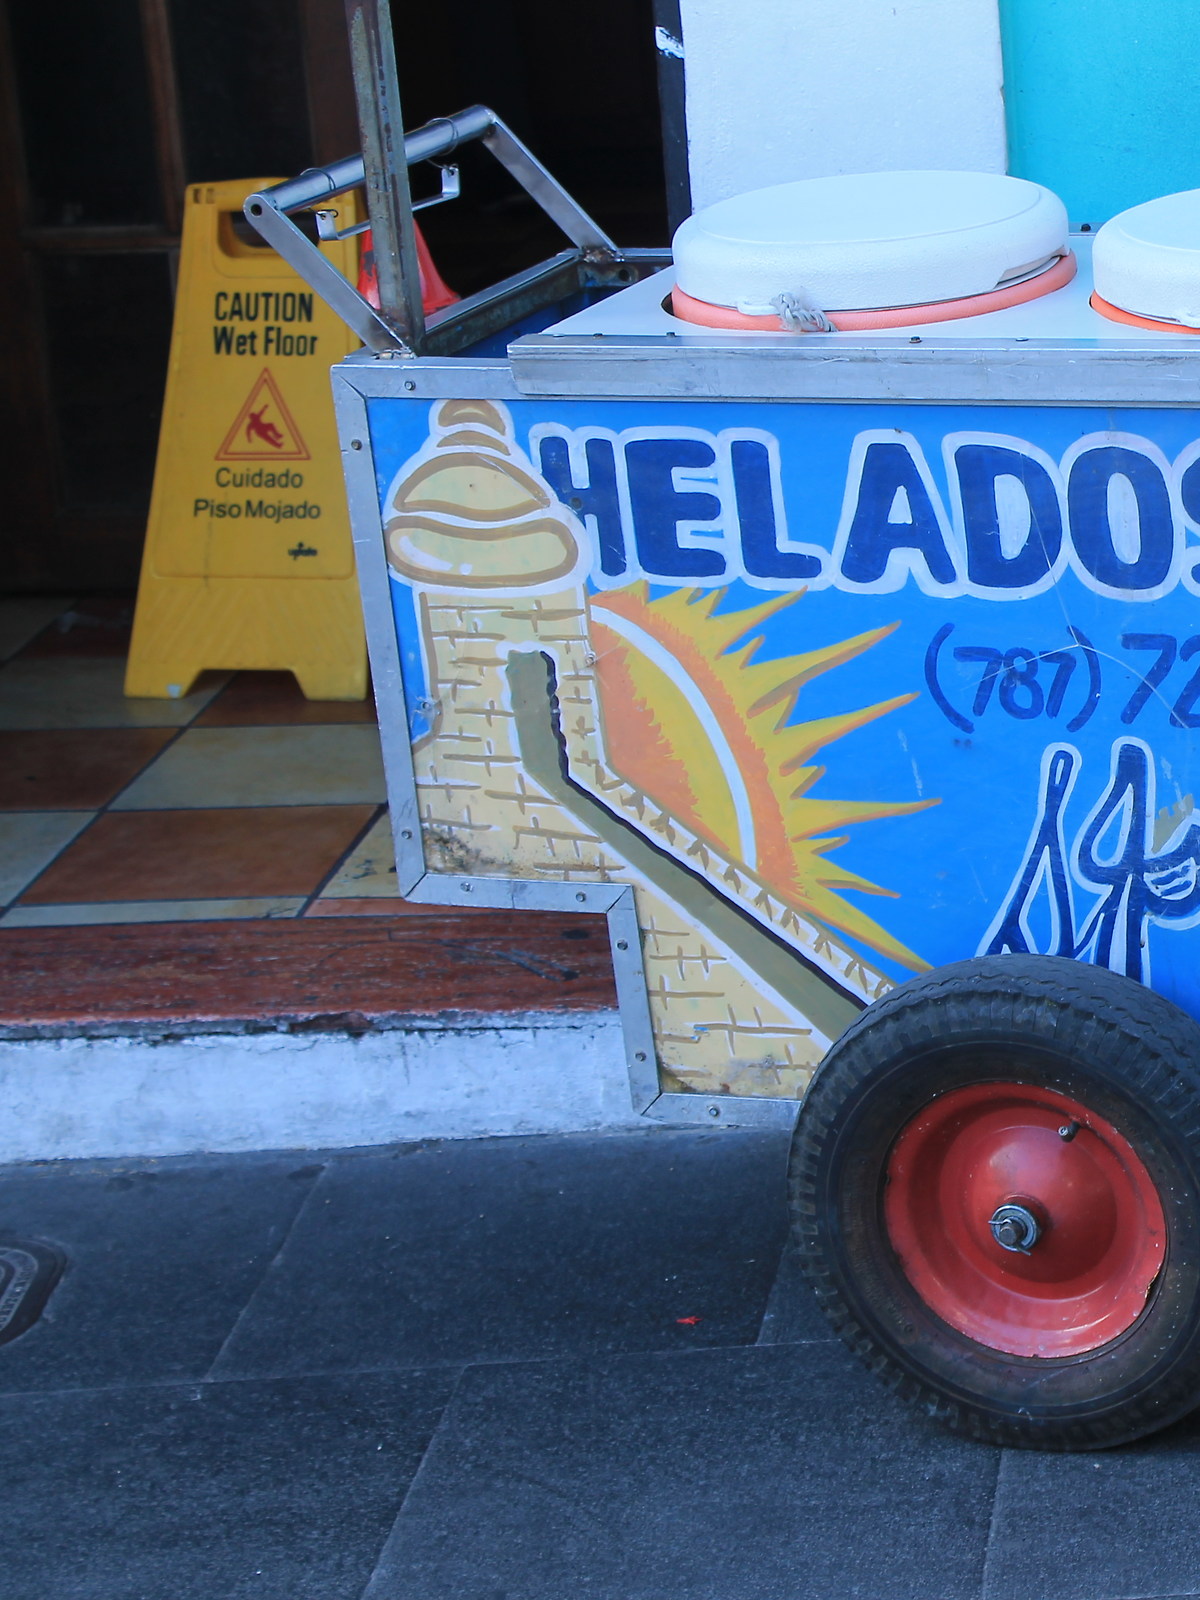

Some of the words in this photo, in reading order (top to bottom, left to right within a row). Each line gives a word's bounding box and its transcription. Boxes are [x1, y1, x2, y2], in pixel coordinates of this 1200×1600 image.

[213, 291, 314, 322] CAUTION
[213, 326, 257, 356] Wet
[263, 326, 318, 356] Floor
[215, 467, 303, 488] Cuidado
[193, 499, 242, 519] Piso
[245, 499, 321, 524] Mojado
[923, 622, 1101, 733] (787)
